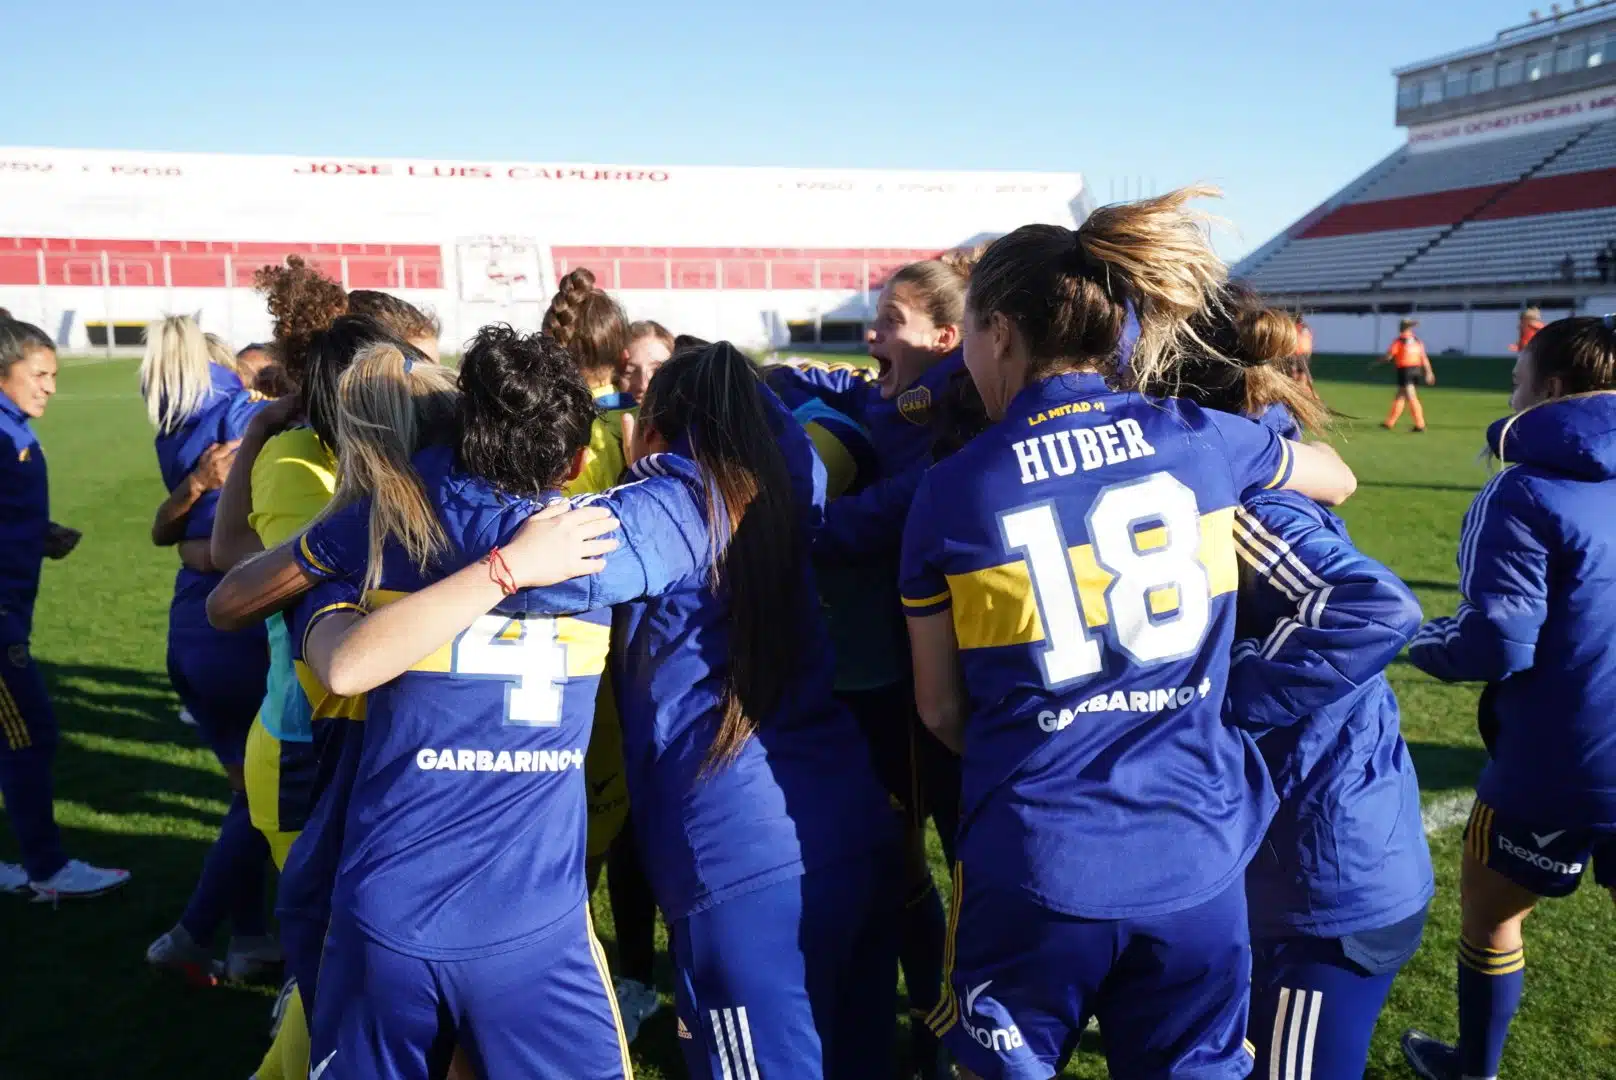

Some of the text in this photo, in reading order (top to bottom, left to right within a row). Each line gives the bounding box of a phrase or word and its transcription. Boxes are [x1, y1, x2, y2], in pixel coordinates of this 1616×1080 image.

[293, 161, 670, 183] JOSE LUIS CAPURRO
[1028, 412, 1047, 426] LA
[1048, 401, 1091, 419] MITAD
[1012, 418, 1156, 484] HUBER
[996, 471, 1212, 691] 18
[450, 614, 568, 728] 4
[1497, 834, 1583, 875] Rexona
